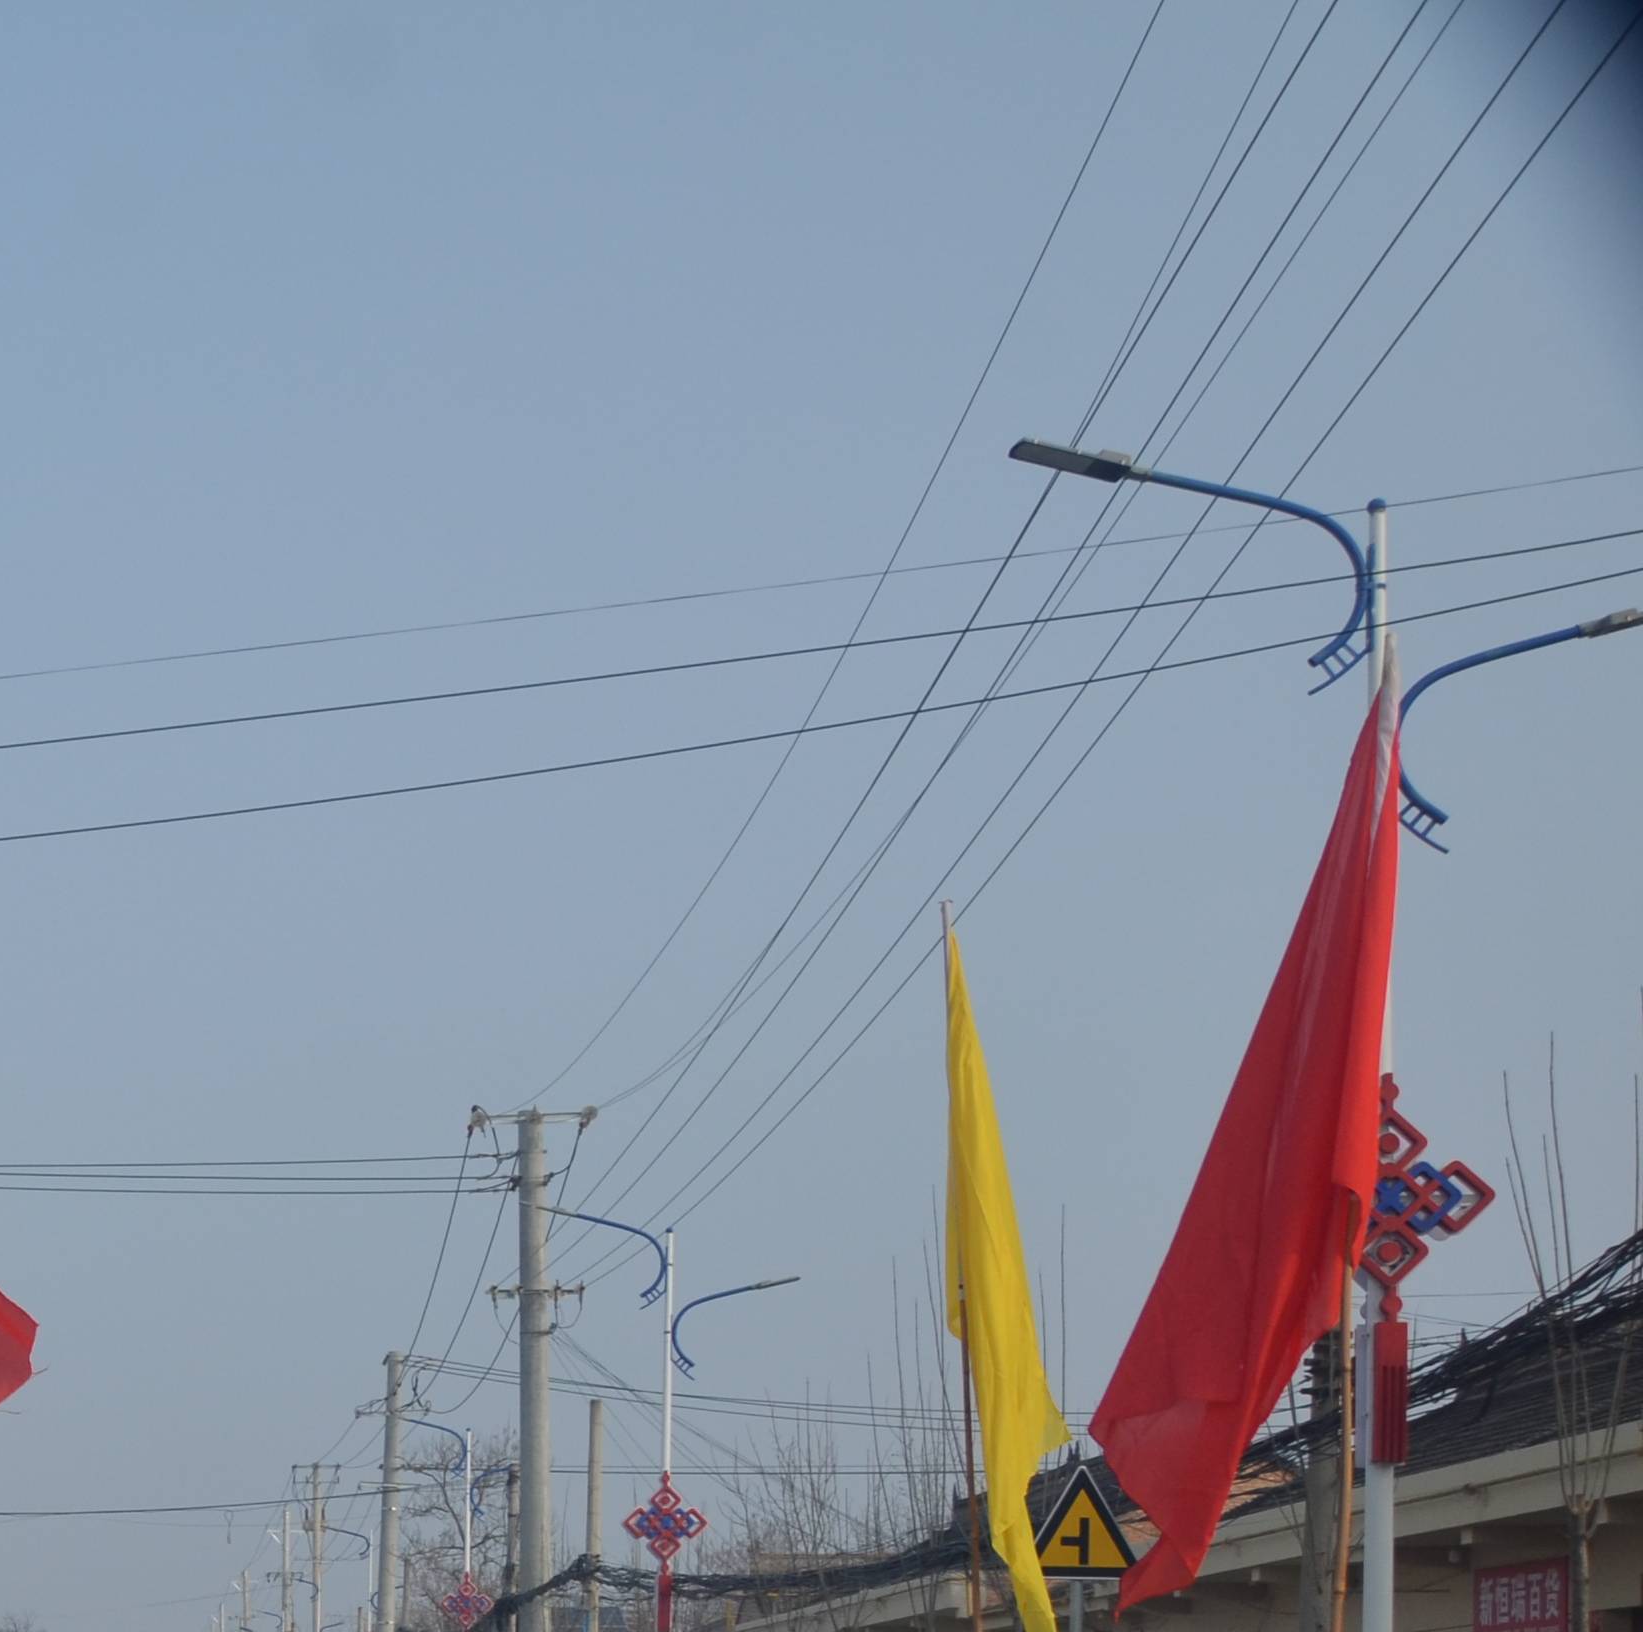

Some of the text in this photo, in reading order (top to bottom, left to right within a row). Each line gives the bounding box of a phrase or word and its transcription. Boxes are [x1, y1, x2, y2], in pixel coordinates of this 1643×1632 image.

[1479, 1568, 1560, 1628] 新恒瑞百货
